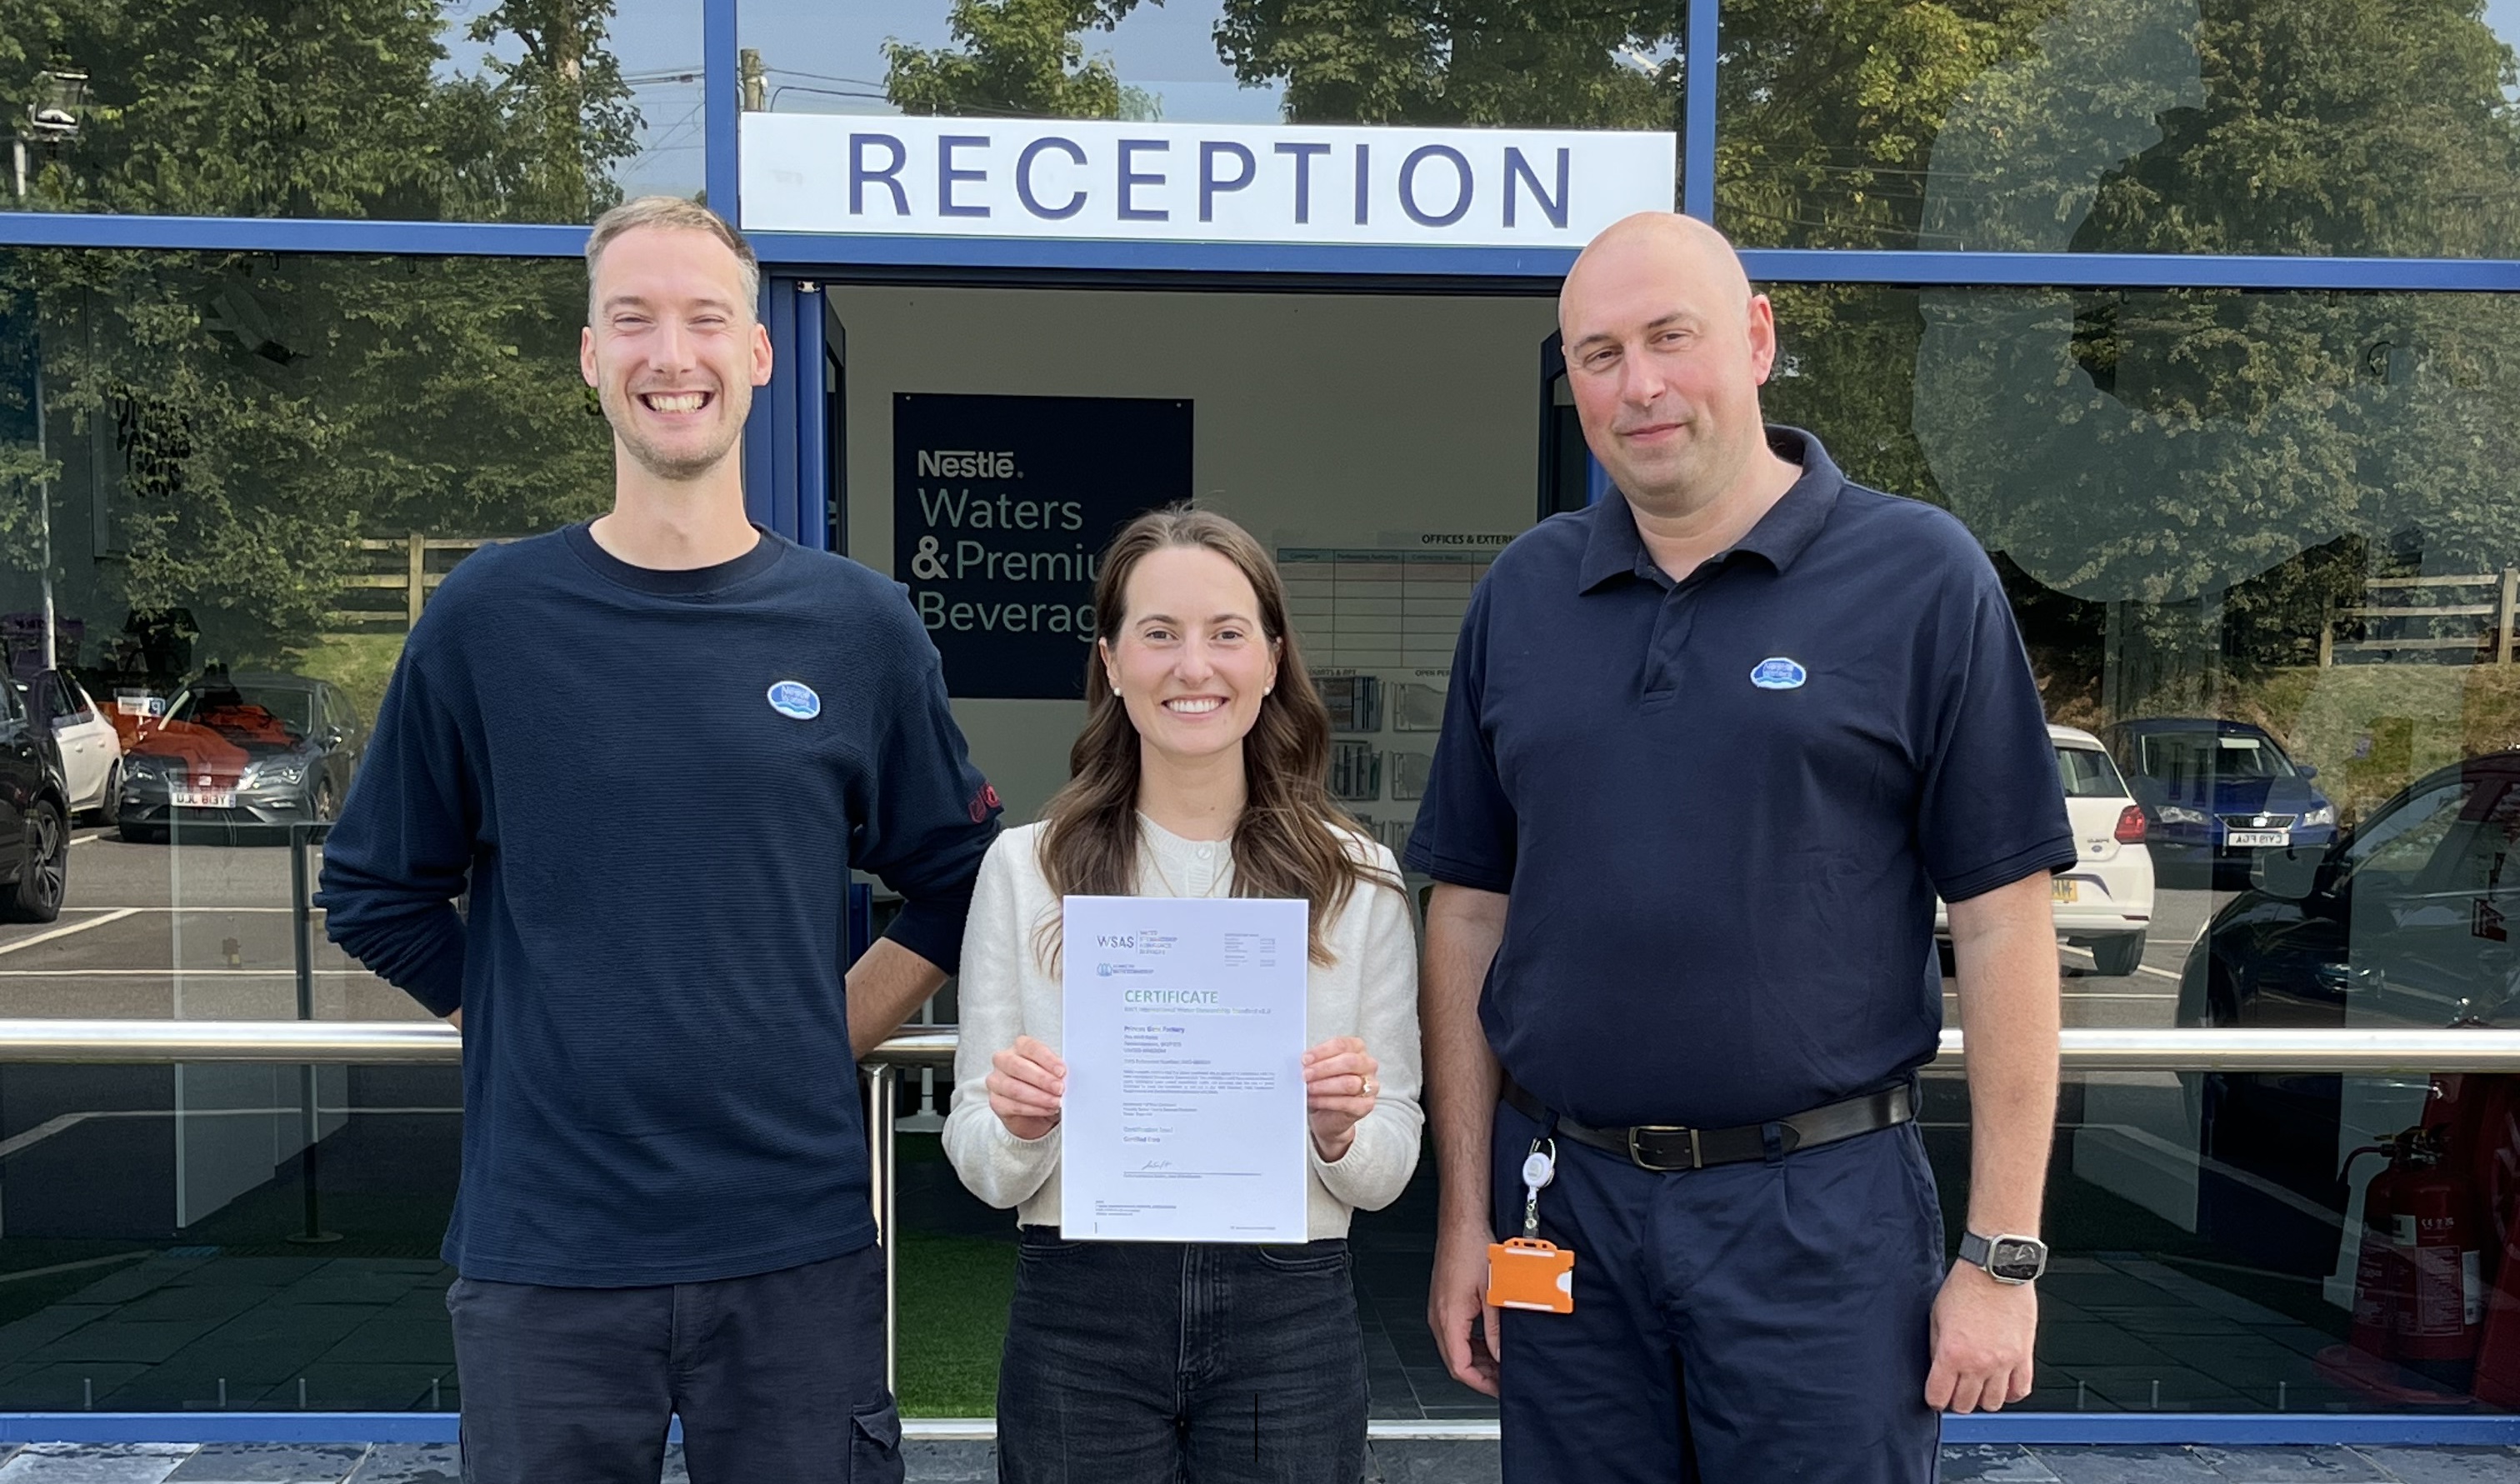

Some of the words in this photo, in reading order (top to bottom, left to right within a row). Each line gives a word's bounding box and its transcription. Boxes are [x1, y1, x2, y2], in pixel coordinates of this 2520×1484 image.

[848, 133, 1571, 229] RECEPTION
[918, 488, 1082, 531] Waters
[1422, 534, 1464, 544] OFFICES
[1467, 535, 1474, 544] &
[918, 591, 1098, 643] Beverag
[1097, 934, 1134, 949] WSAS
[1125, 989, 1218, 1004] CERTIFICATE
